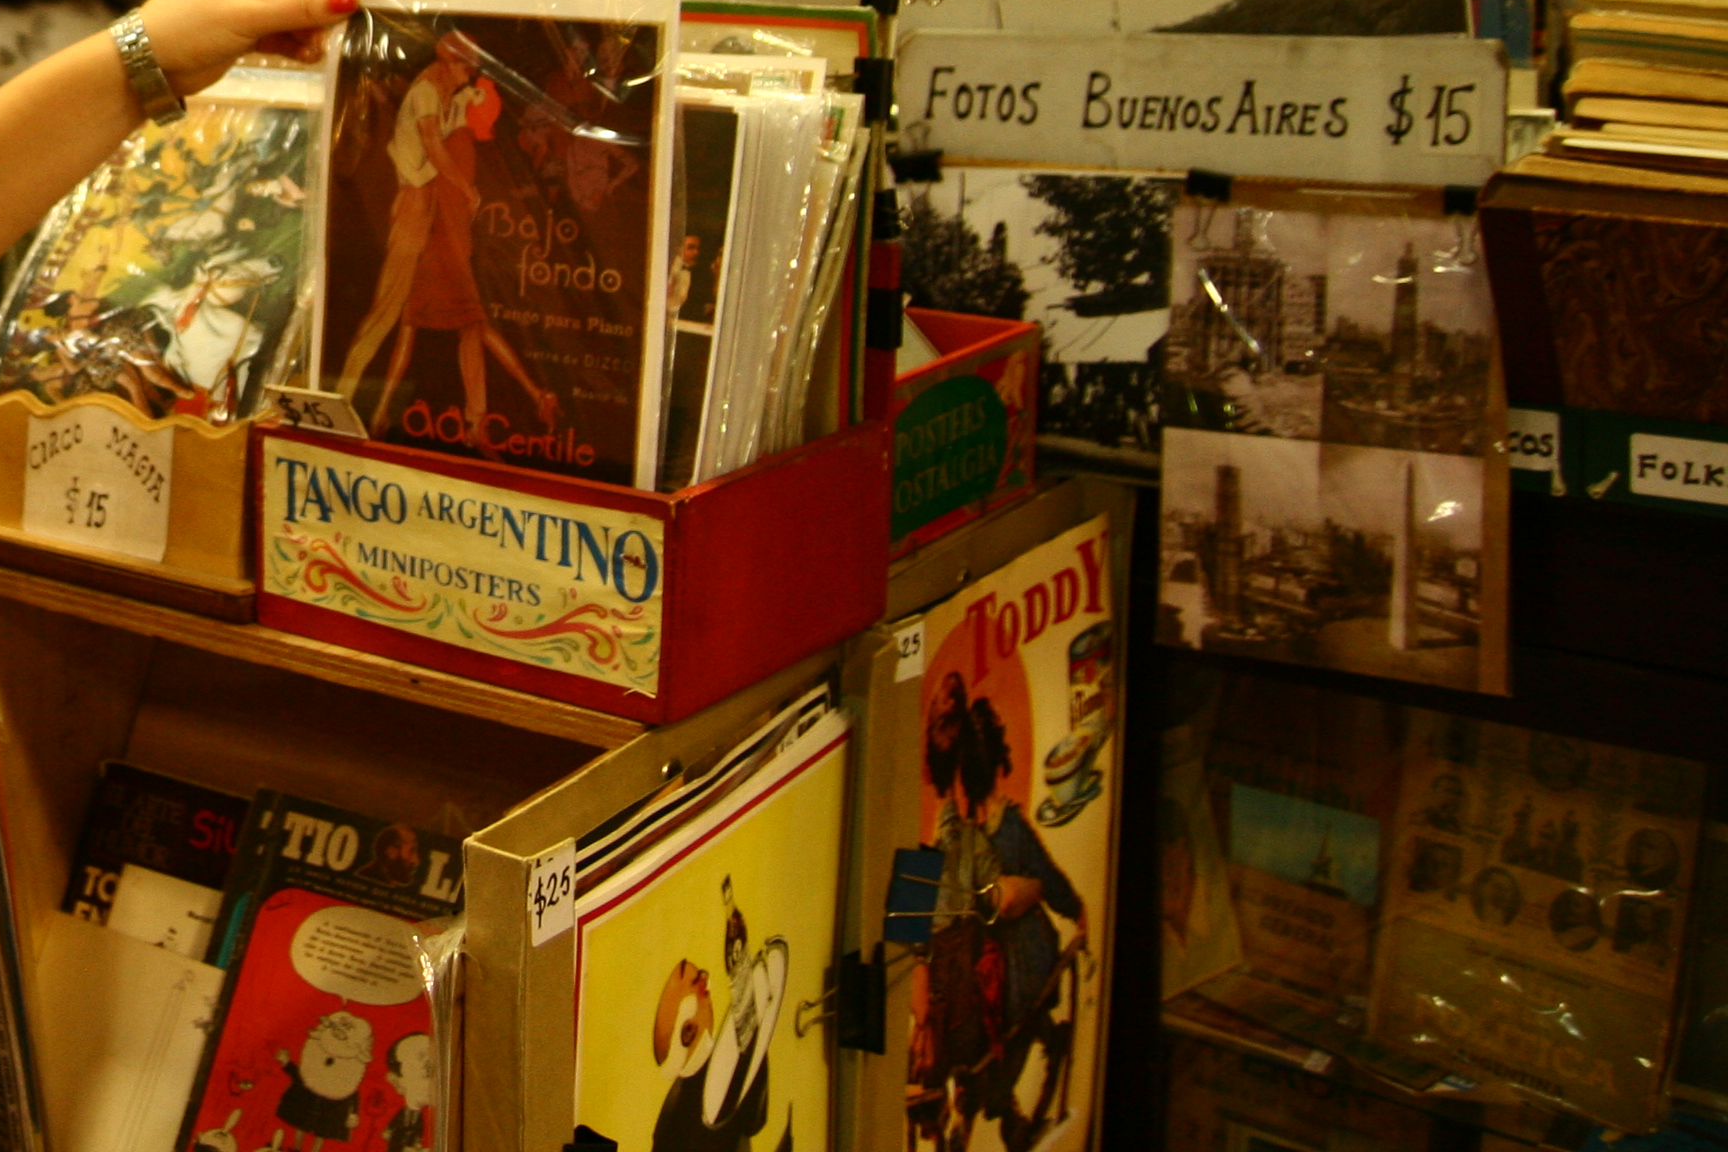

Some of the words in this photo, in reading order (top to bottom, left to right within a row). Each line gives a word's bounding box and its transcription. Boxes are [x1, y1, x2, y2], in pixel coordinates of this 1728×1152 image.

[923, 66, 1042, 125] FOTOS
[1082, 70, 1222, 134] BUENOS
[1225, 80, 1350, 138] AIRES
[1384, 74, 1476, 147] $15
[479, 201, 579, 259] Bajo
[518, 243, 622, 298] fondo
[490, 303, 540, 324] Tango
[277, 394, 336, 428] $15
[895, 395, 987, 466] POSTERS
[29, 424, 83, 471] CIRCO
[106, 426, 165, 503] MAGIA
[275, 457, 407, 524] TANGO
[417, 491, 659, 604] ARGENTINO
[357, 542, 541, 607] MINIPOSTERS
[967, 534, 1108, 688] TODDY
[281, 811, 360, 872] TIO
[534, 865, 570, 929] $25
